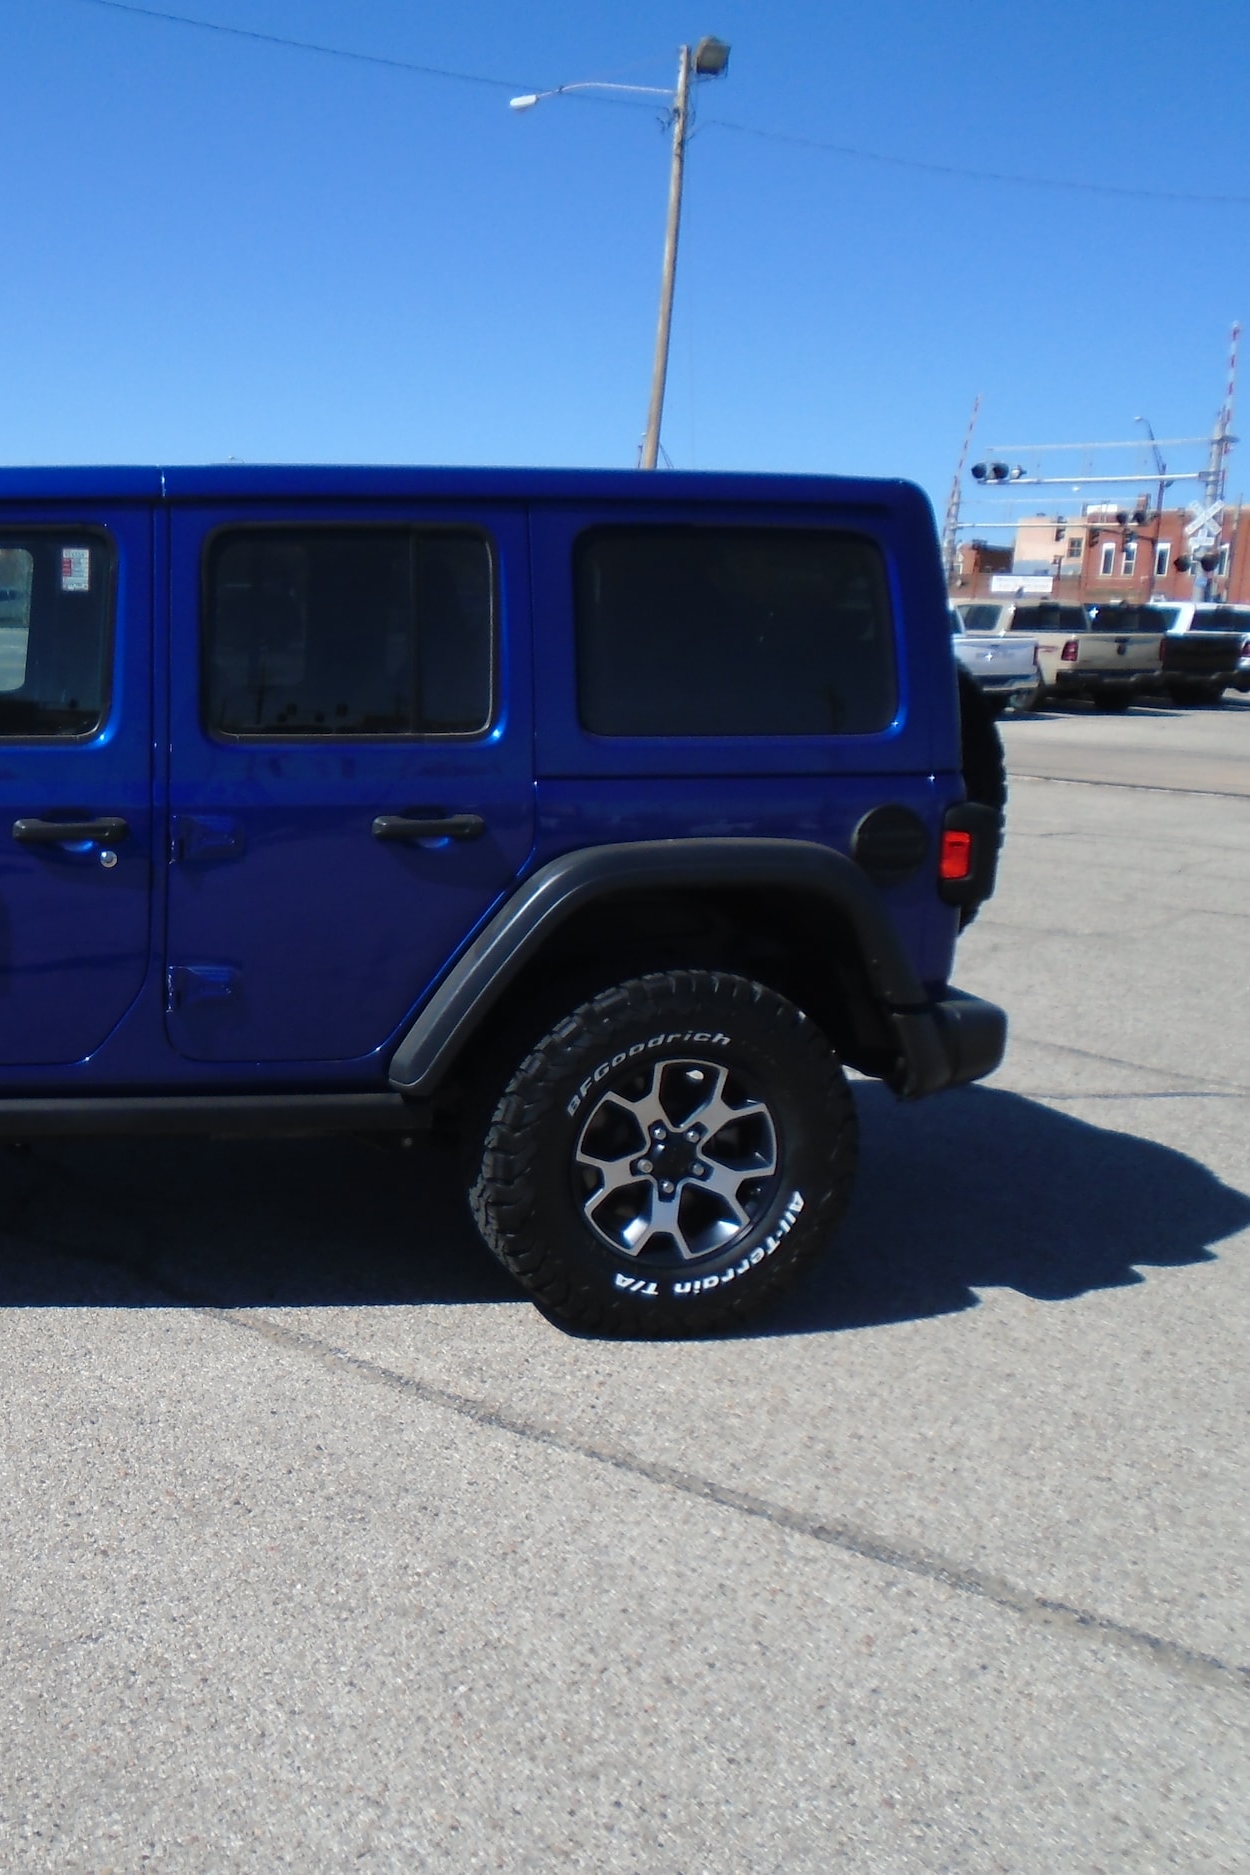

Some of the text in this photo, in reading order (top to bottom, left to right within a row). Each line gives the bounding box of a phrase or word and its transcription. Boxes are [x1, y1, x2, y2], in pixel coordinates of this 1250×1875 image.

[566, 1029, 732, 1117] BFGoodrich
[614, 1190, 806, 1296] All-Terrain T/A
